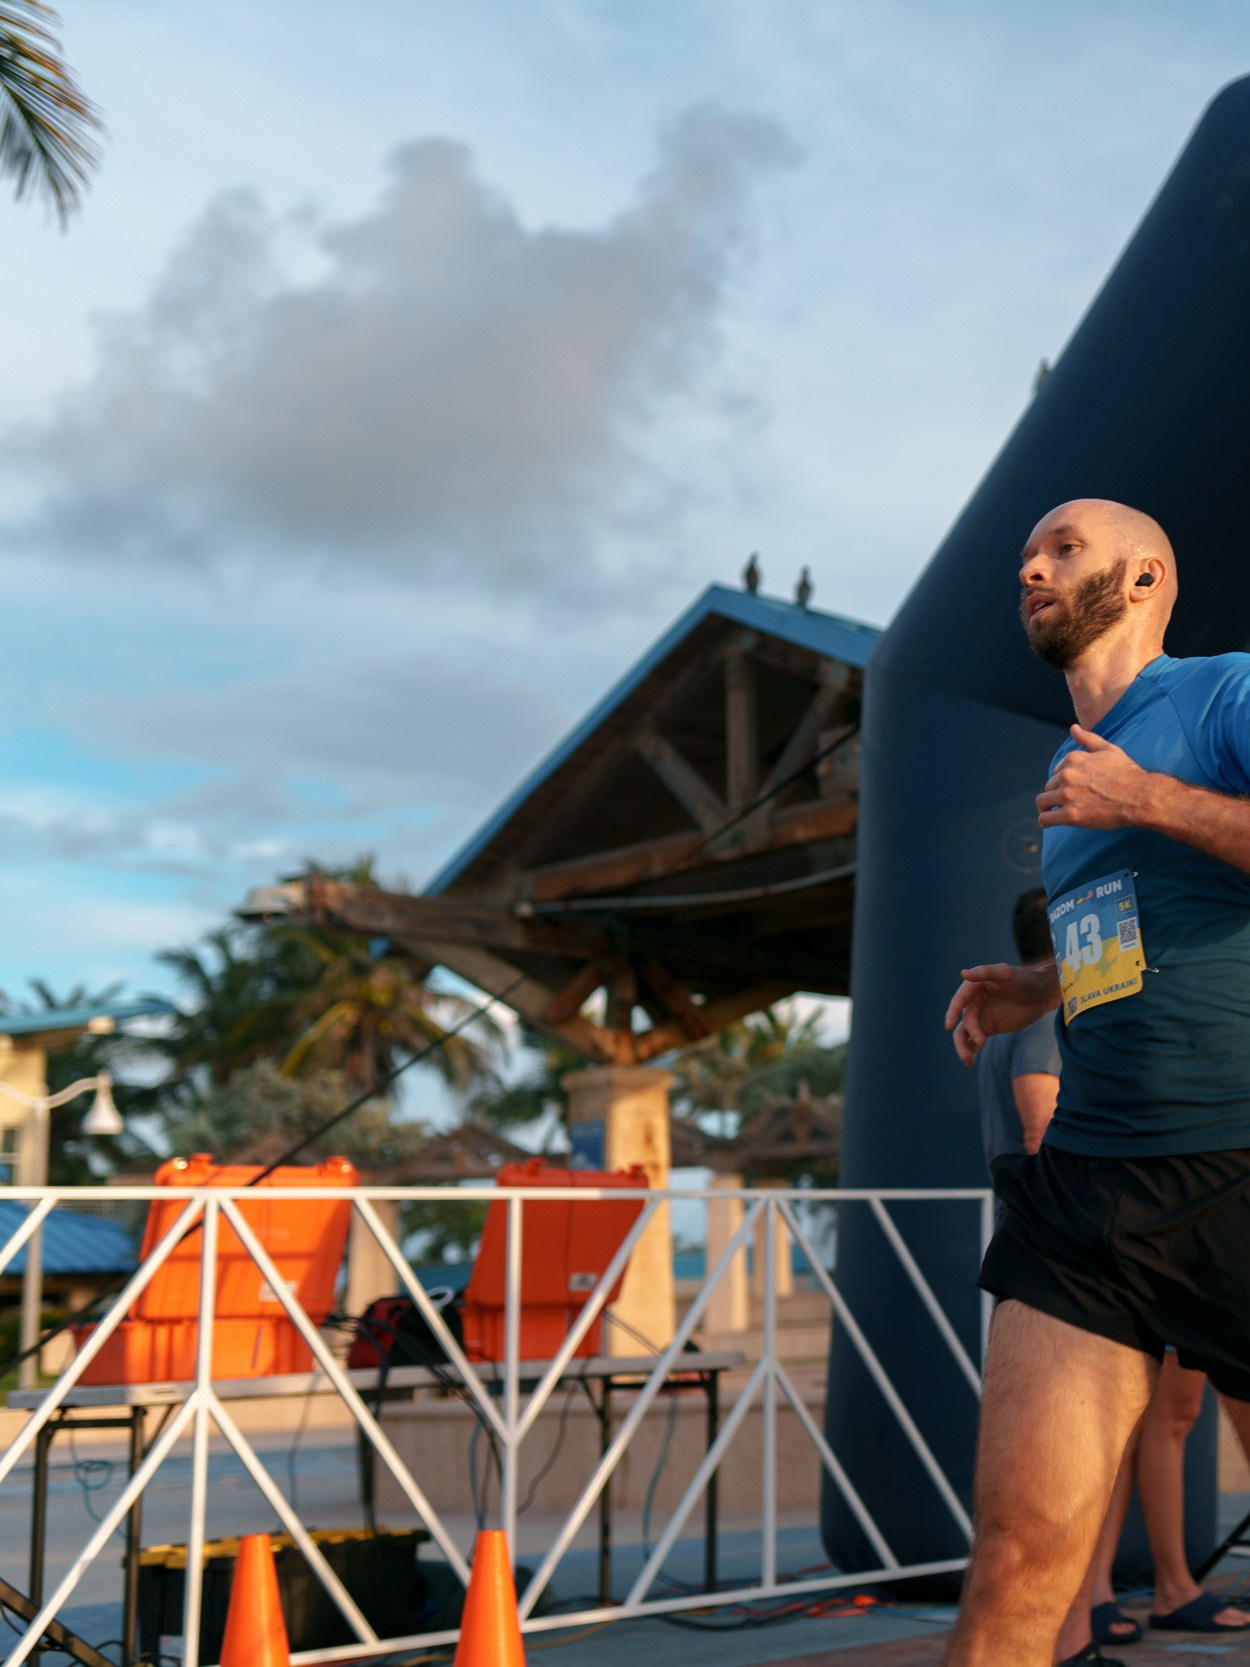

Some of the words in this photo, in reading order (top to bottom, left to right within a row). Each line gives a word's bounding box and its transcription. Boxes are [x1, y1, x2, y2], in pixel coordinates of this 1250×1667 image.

[1096, 880, 1122, 898] RUN
[1119, 900, 1132, 911] 5K
[1080, 990, 1102, 1003] SLAVA
